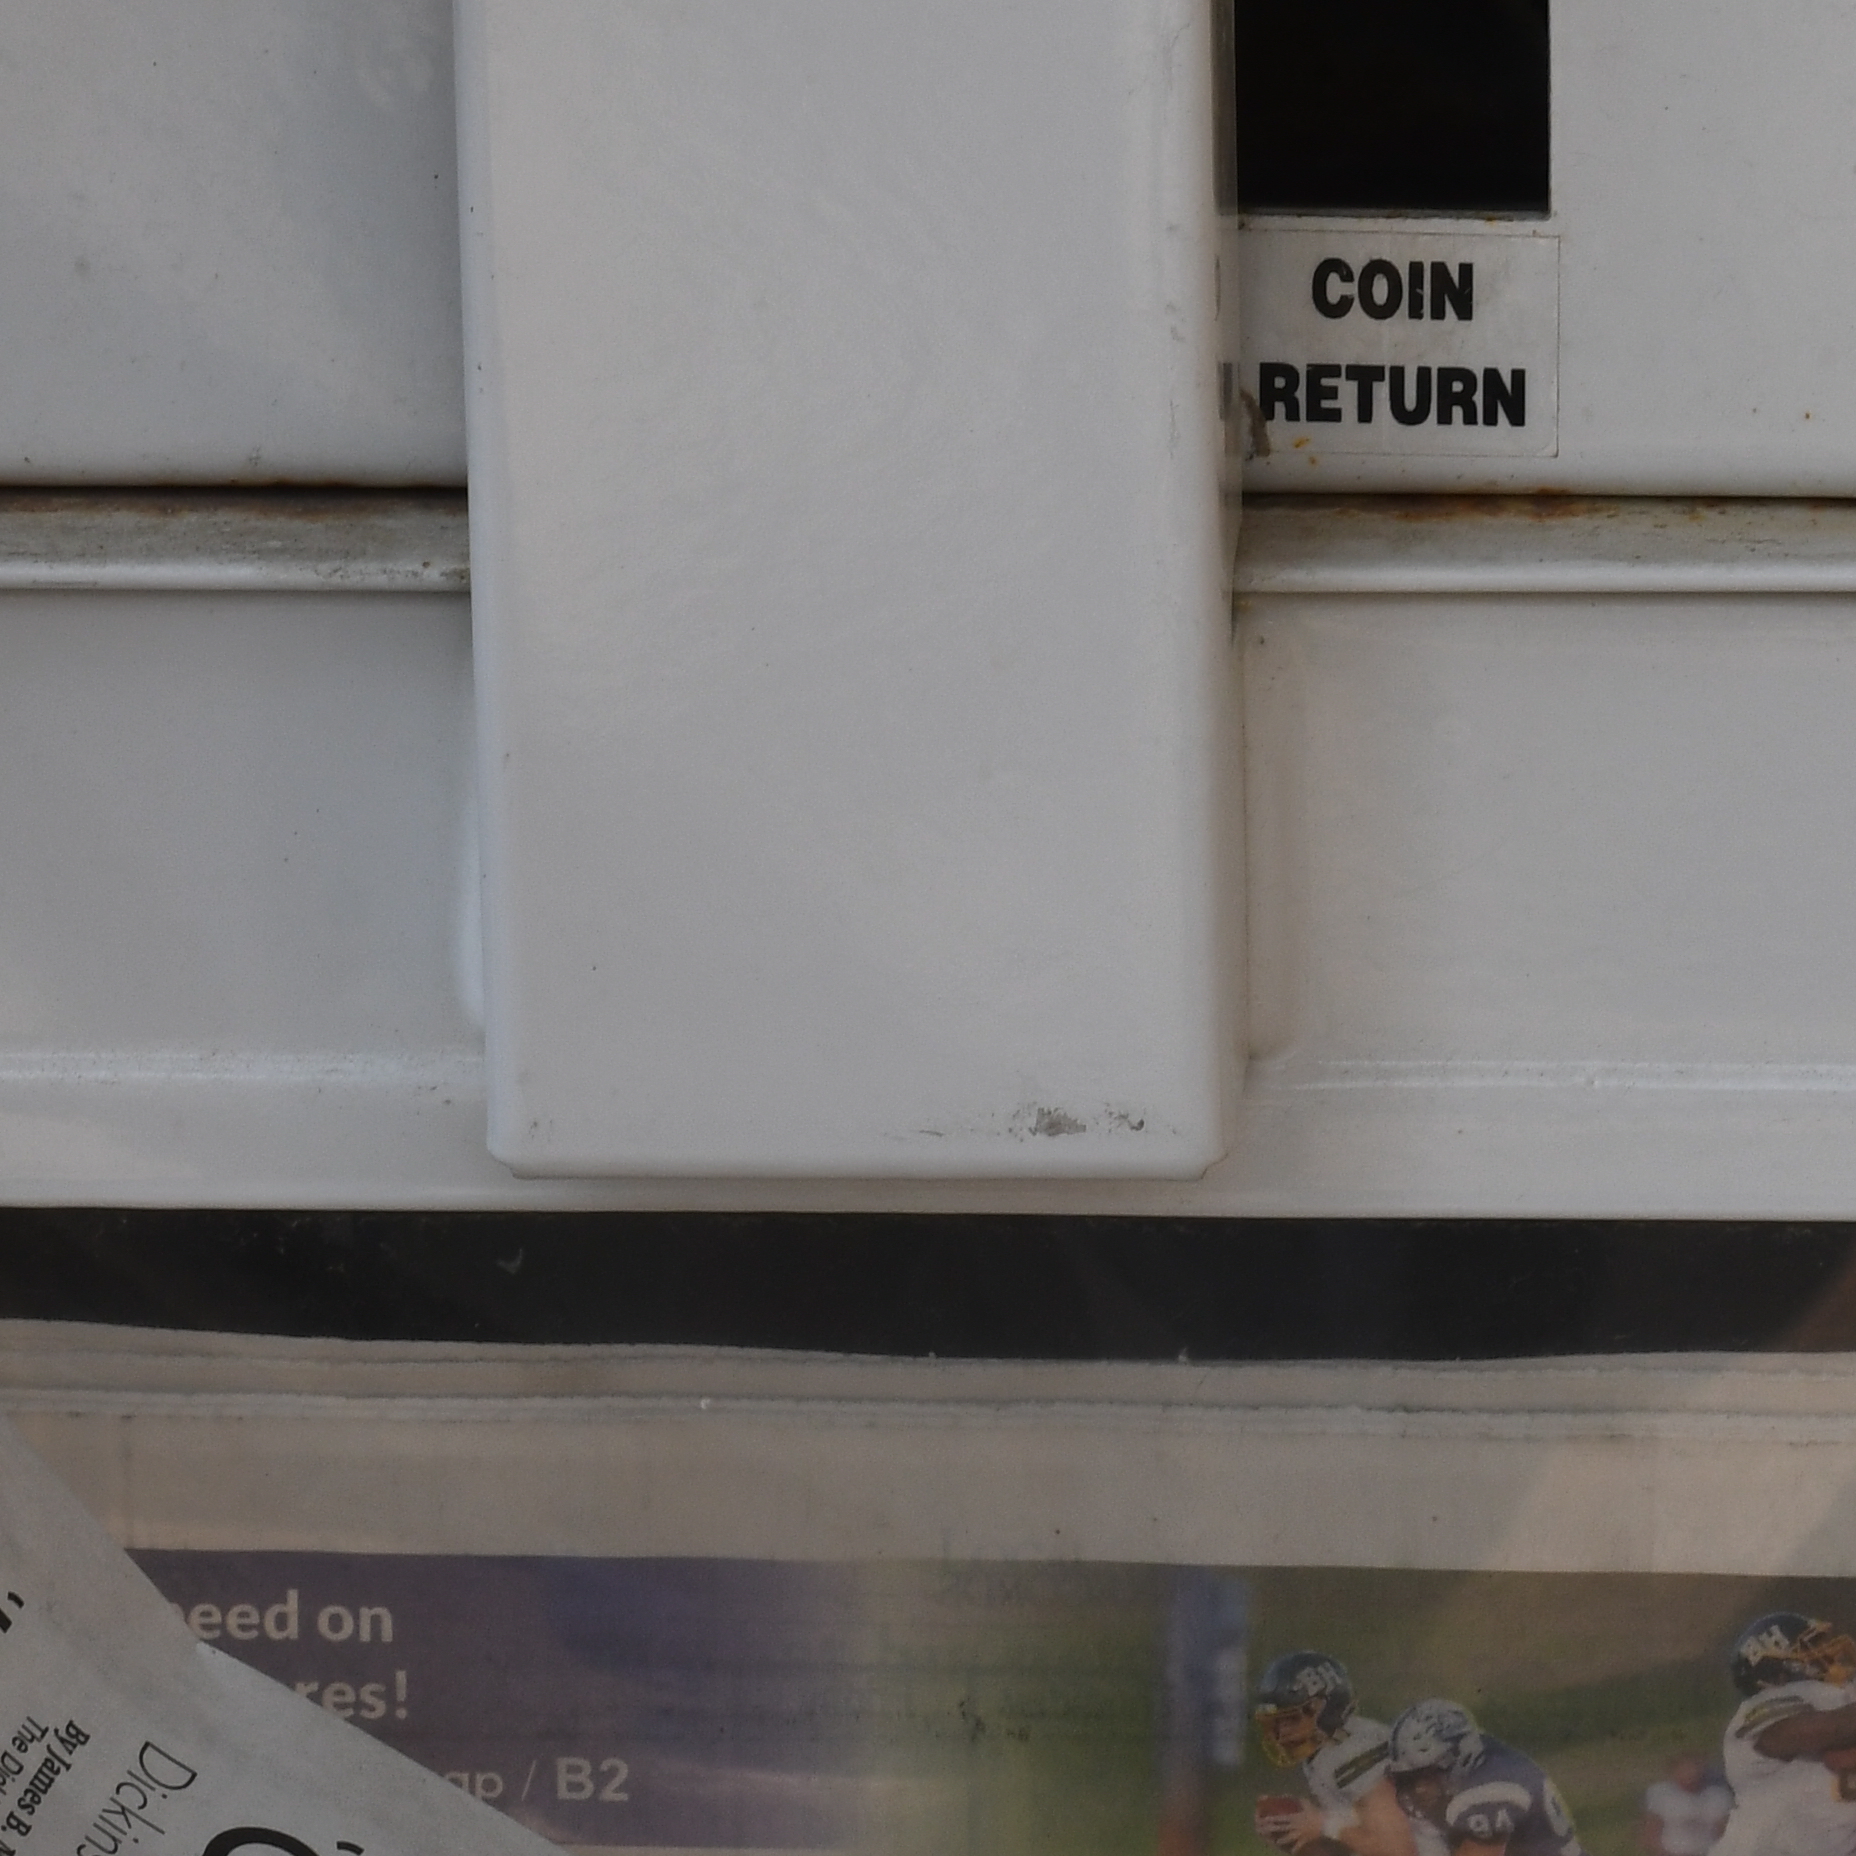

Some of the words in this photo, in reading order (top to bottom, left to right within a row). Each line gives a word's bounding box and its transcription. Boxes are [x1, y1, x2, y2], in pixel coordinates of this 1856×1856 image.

[1310, 256, 1474, 321] COIN
[1258, 362, 1526, 427] RETURN
[177, 1588, 300, 1641] eed
[316, 1604, 393, 1642] on
[10, 1715, 50, 1754] The
[52, 1718, 91, 1756] By
[16, 1742, 72, 1816] James
[555, 1756, 629, 1802] B2
[0, 1809, 33, 1837] B.
